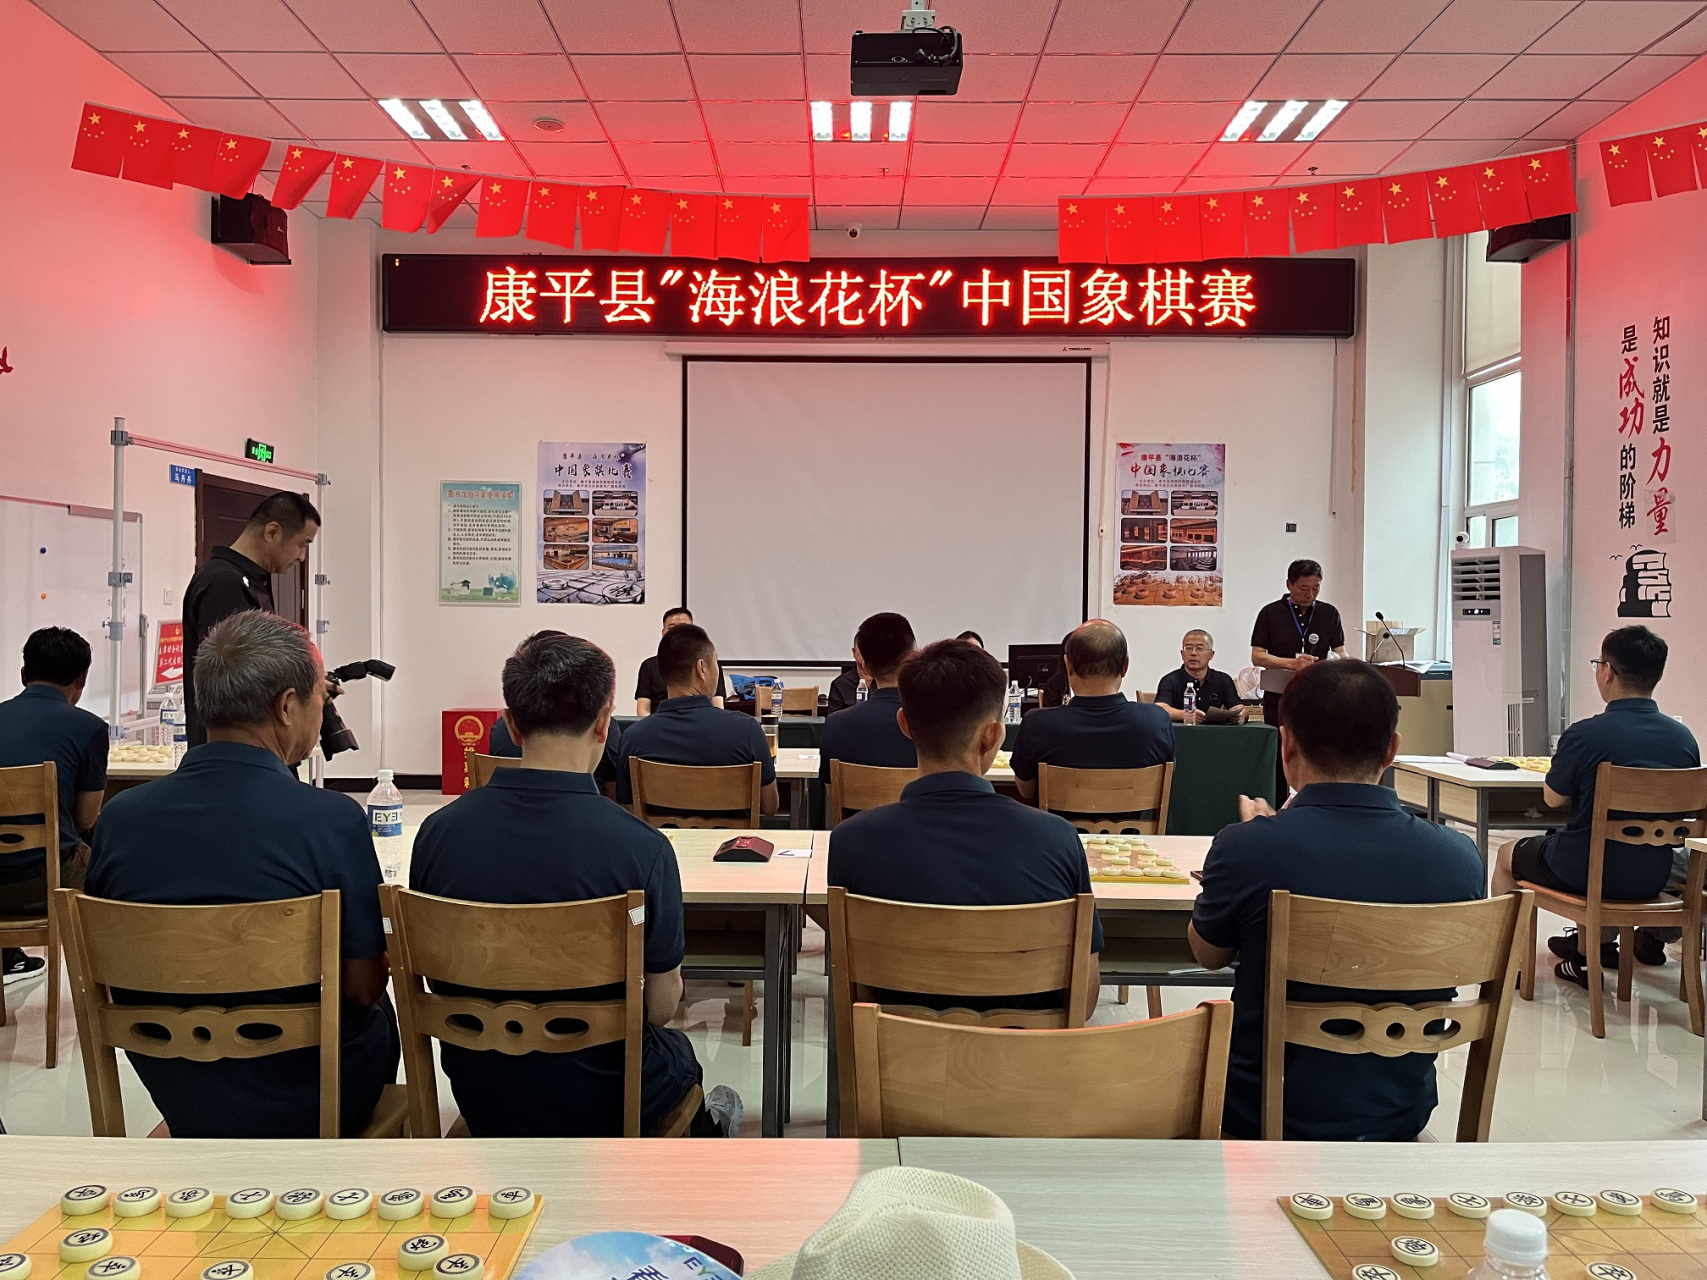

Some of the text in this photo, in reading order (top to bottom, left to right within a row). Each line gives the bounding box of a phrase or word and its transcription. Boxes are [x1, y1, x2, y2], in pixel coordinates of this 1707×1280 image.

[554, 463, 633, 479] 中国象棋比赛
[1130, 463, 1211, 479] 中国象棋比赛
[1618, 324, 1645, 529] 是成功的阶梯
[1646, 316, 1672, 535] 知识就是力量
